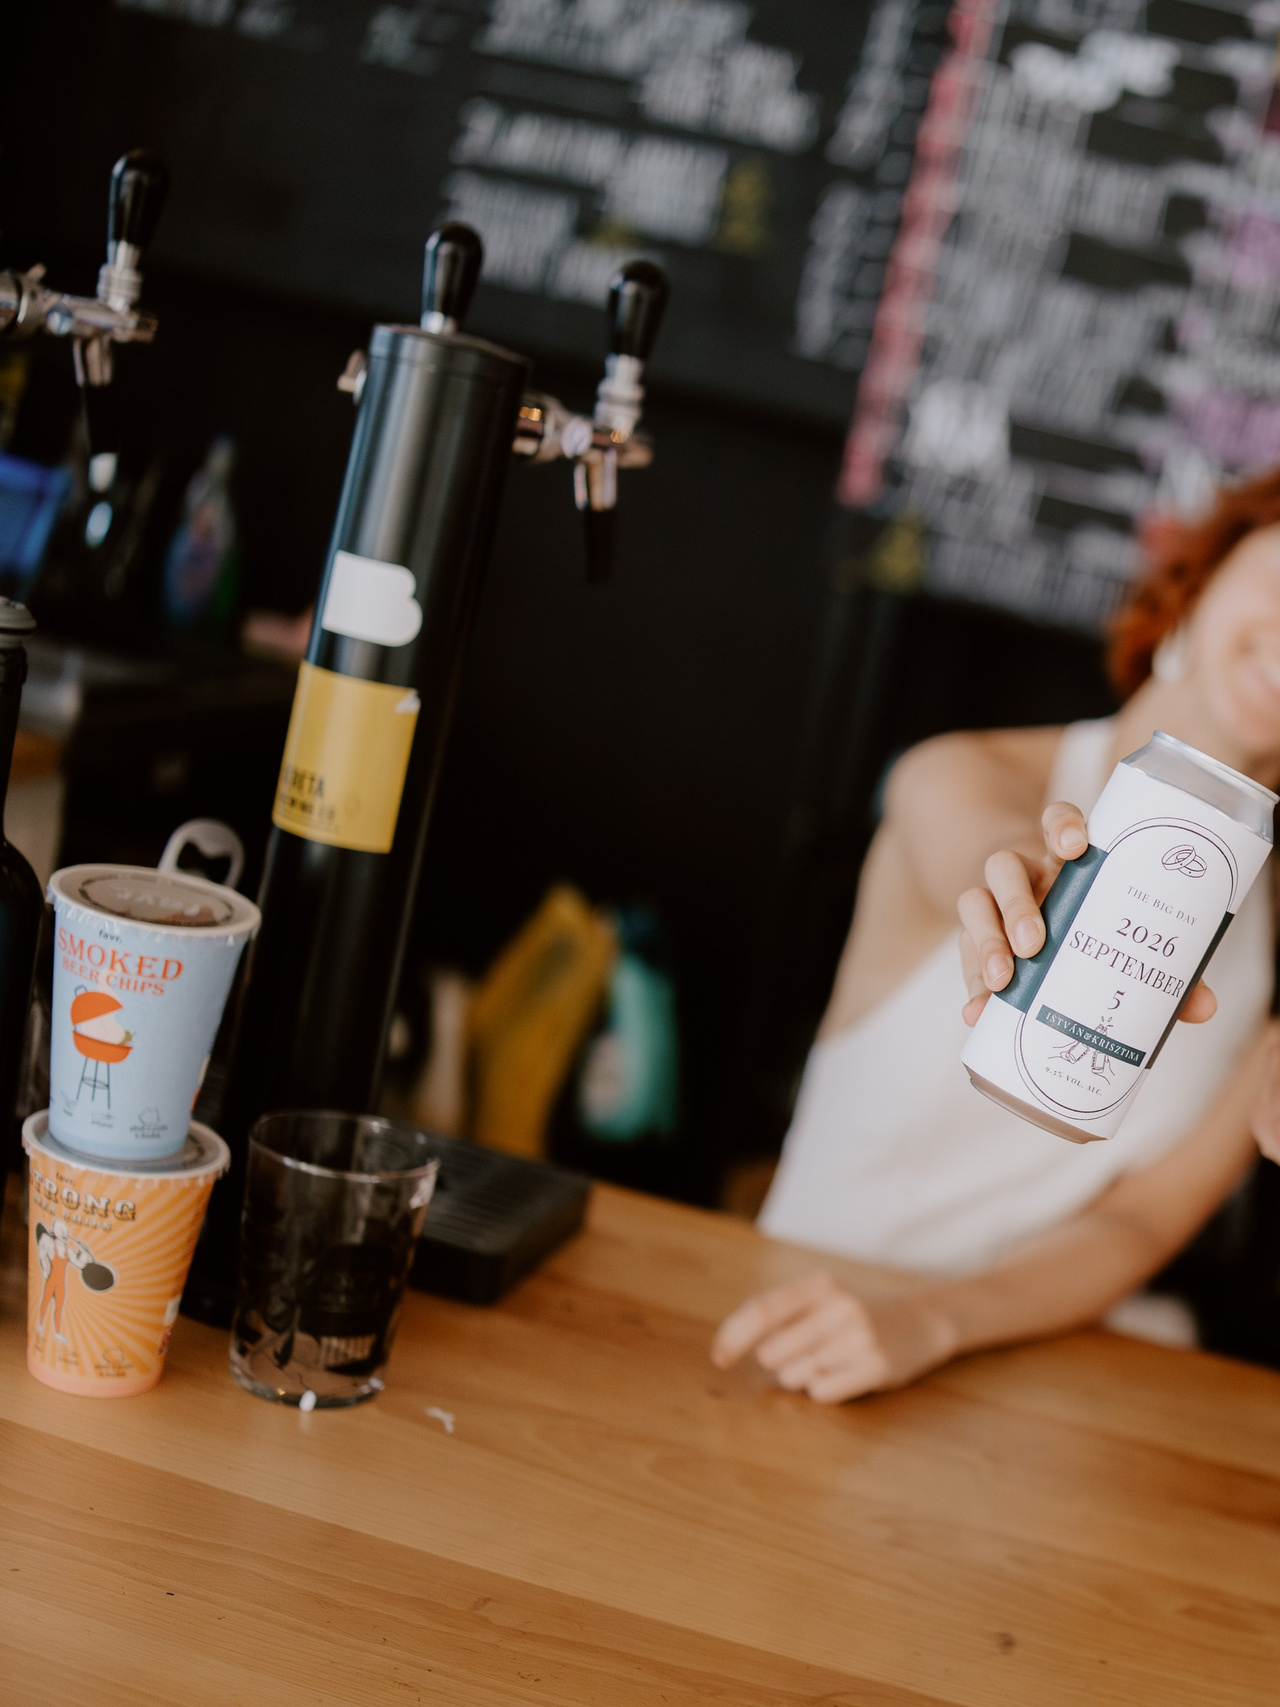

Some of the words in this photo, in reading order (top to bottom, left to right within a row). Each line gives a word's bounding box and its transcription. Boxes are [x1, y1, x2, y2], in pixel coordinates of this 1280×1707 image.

[1126, 885, 1151, 904] THE
[1152, 898, 1174, 916] BIG
[1175, 910, 1199, 927] DAY
[57, 926, 184, 981] SMOKED
[1115, 917, 1180, 958] 2026
[62, 956, 99, 985] BEER
[105, 974, 165, 996] CHIPS
[1068, 930, 1186, 998] SEPTEMBER
[1106, 990, 1126, 1011] 5
[29, 1168, 137, 1221] TRONG
